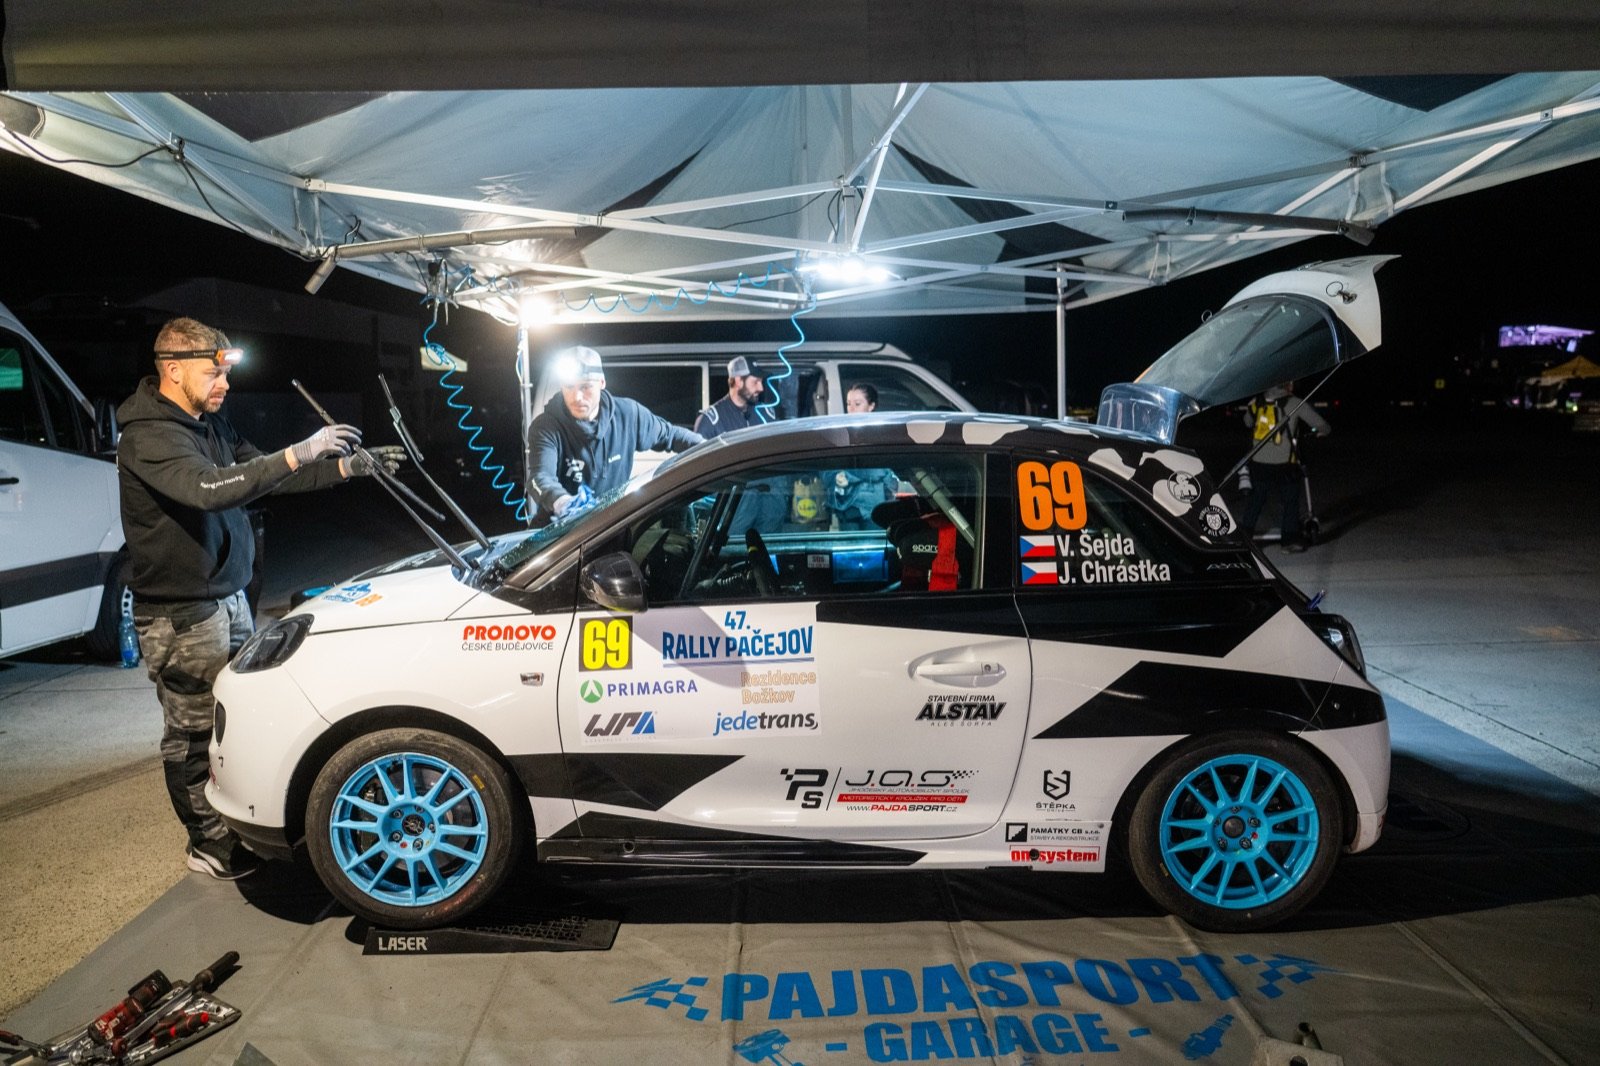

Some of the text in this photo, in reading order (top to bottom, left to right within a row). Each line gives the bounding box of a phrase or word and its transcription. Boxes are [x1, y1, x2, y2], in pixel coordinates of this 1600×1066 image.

[1016, 460, 1088, 531] 69
[1057, 528, 1135, 560] V. Šejda
[1058, 559, 1172, 585] J. Chrástka
[724, 611, 751, 630] 47.
[463, 625, 557, 641] PRONOVO
[662, 625, 813, 660] RALLY PAČEJOV
[461, 641, 554, 651] ČESKÉ BUDĚJOVICE
[583, 619, 630, 669] 69
[740, 669, 817, 687] Rezidence
[607, 679, 698, 697] PRIMAGRA
[741, 688, 796, 704] Božkov
[927, 693, 969, 702] STAVEBNÍ
[915, 702, 1007, 721] ALSTAV
[1035, 802, 1076, 810] ŠTĚPKA
[378, 936, 428, 951] LASER
[721, 953, 1242, 1022] PAJDASPORT
[864, 1012, 1120, 1064] GARAGE
